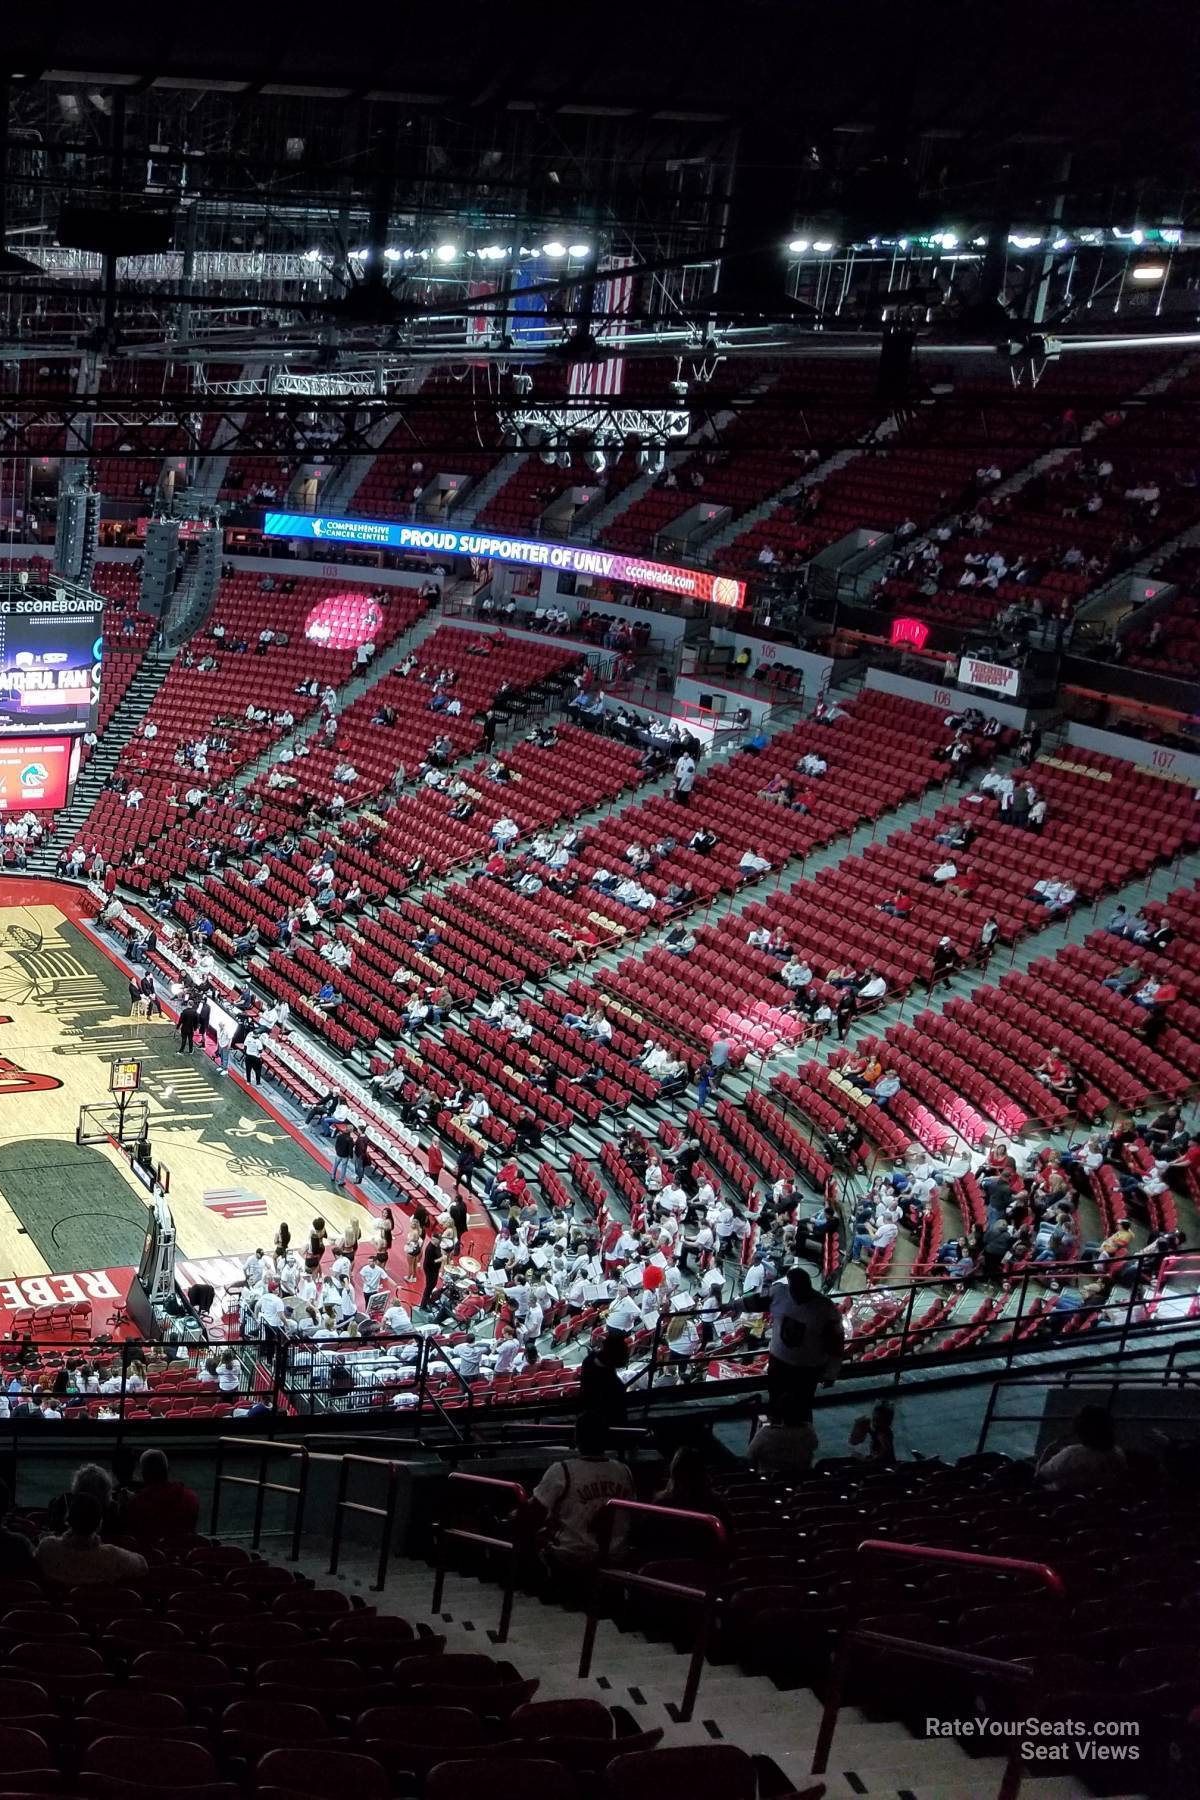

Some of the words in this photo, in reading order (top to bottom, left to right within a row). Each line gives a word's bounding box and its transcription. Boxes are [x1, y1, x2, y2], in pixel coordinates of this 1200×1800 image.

[326, 529, 355, 539] CANCER
[356, 531, 389, 542] CENTERS
[327, 521, 390, 535] COMPREHENSIVE
[400, 528, 458, 551] PROUD
[459, 535, 548, 564] SUPPORTER
[551, 548, 572, 567] OF
[573, 553, 614, 576] UNLV
[322, 565, 338, 577] 103
[625, 564, 695, 590] cccnevada.com
[15, 600, 103, 613] SCOREBOARD
[761, 644, 776, 659] 105
[58, 670, 87, 688] FAN
[934, 689, 950, 706] 106
[1153, 750, 1176, 768] 107
